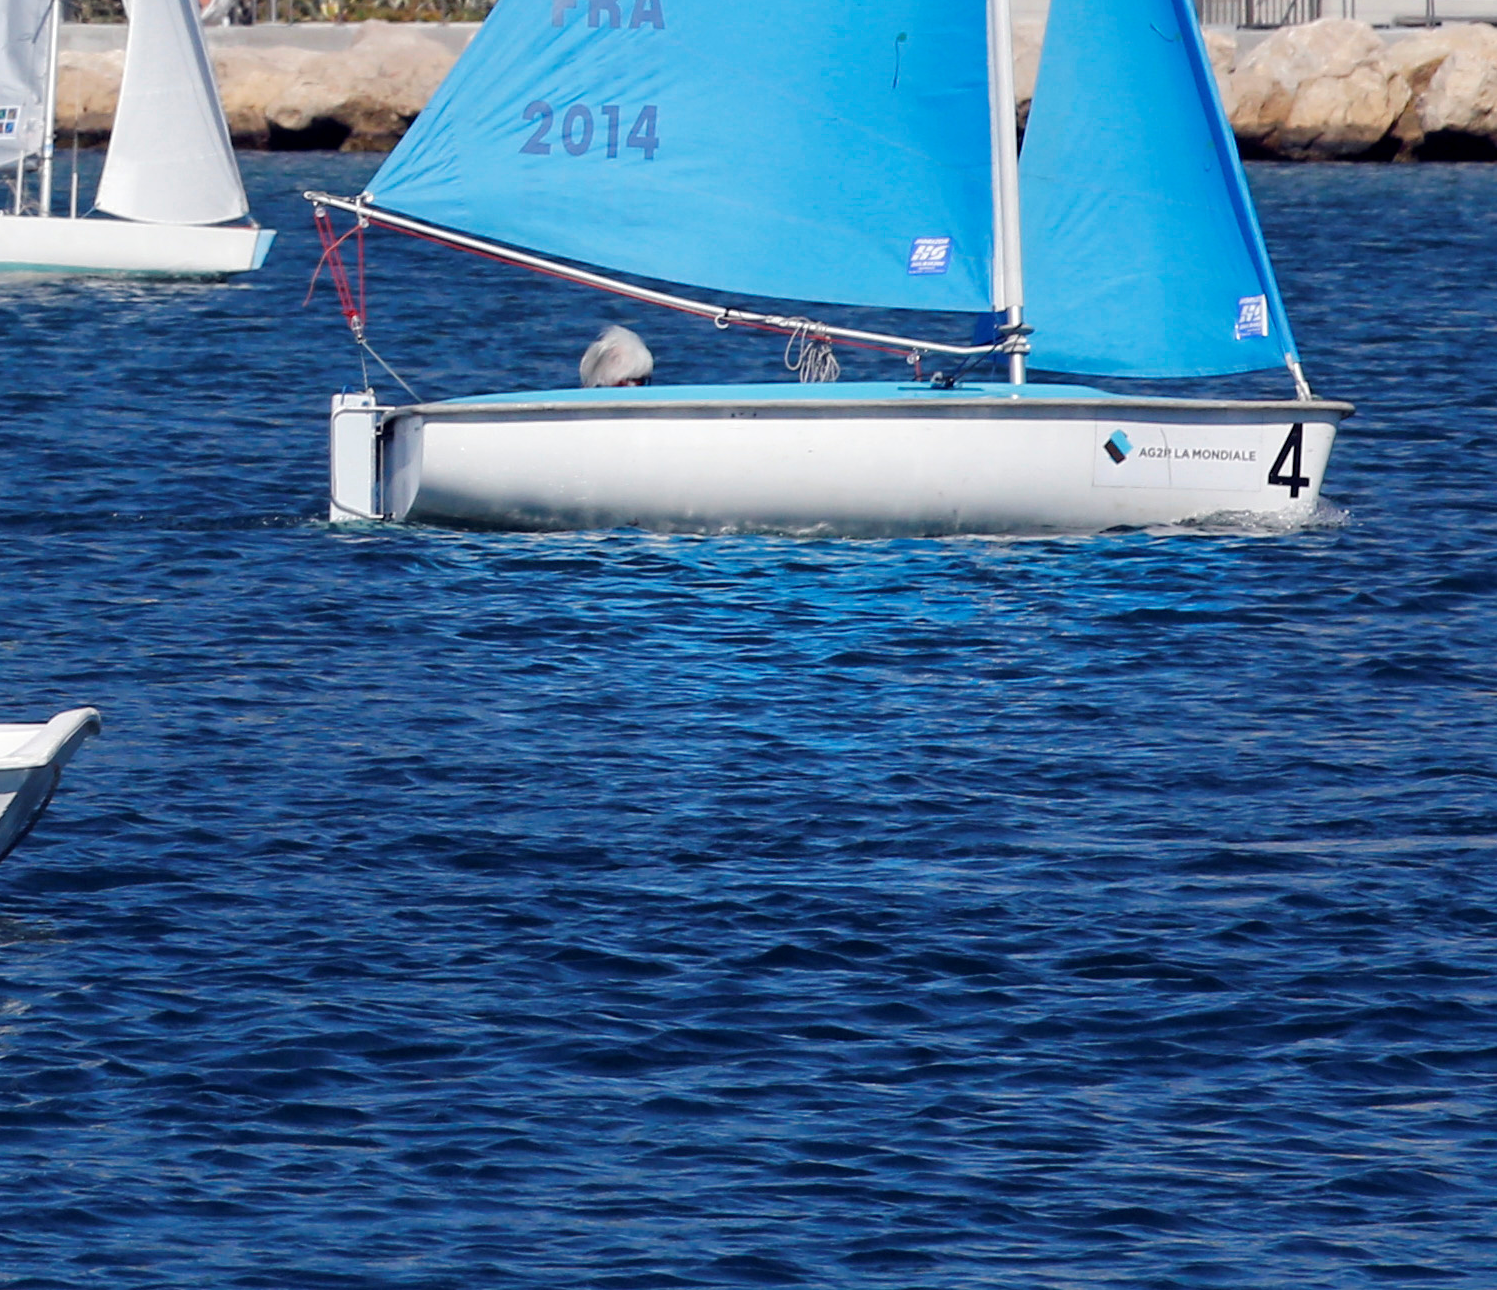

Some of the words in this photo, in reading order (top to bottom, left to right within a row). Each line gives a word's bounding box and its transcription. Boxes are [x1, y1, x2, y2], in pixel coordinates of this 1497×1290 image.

[517, 99, 660, 160] 2014
[1174, 449, 1190, 459] LA
[1192, 449, 1257, 461] MONDIALE
[1267, 422, 1310, 499] 4
